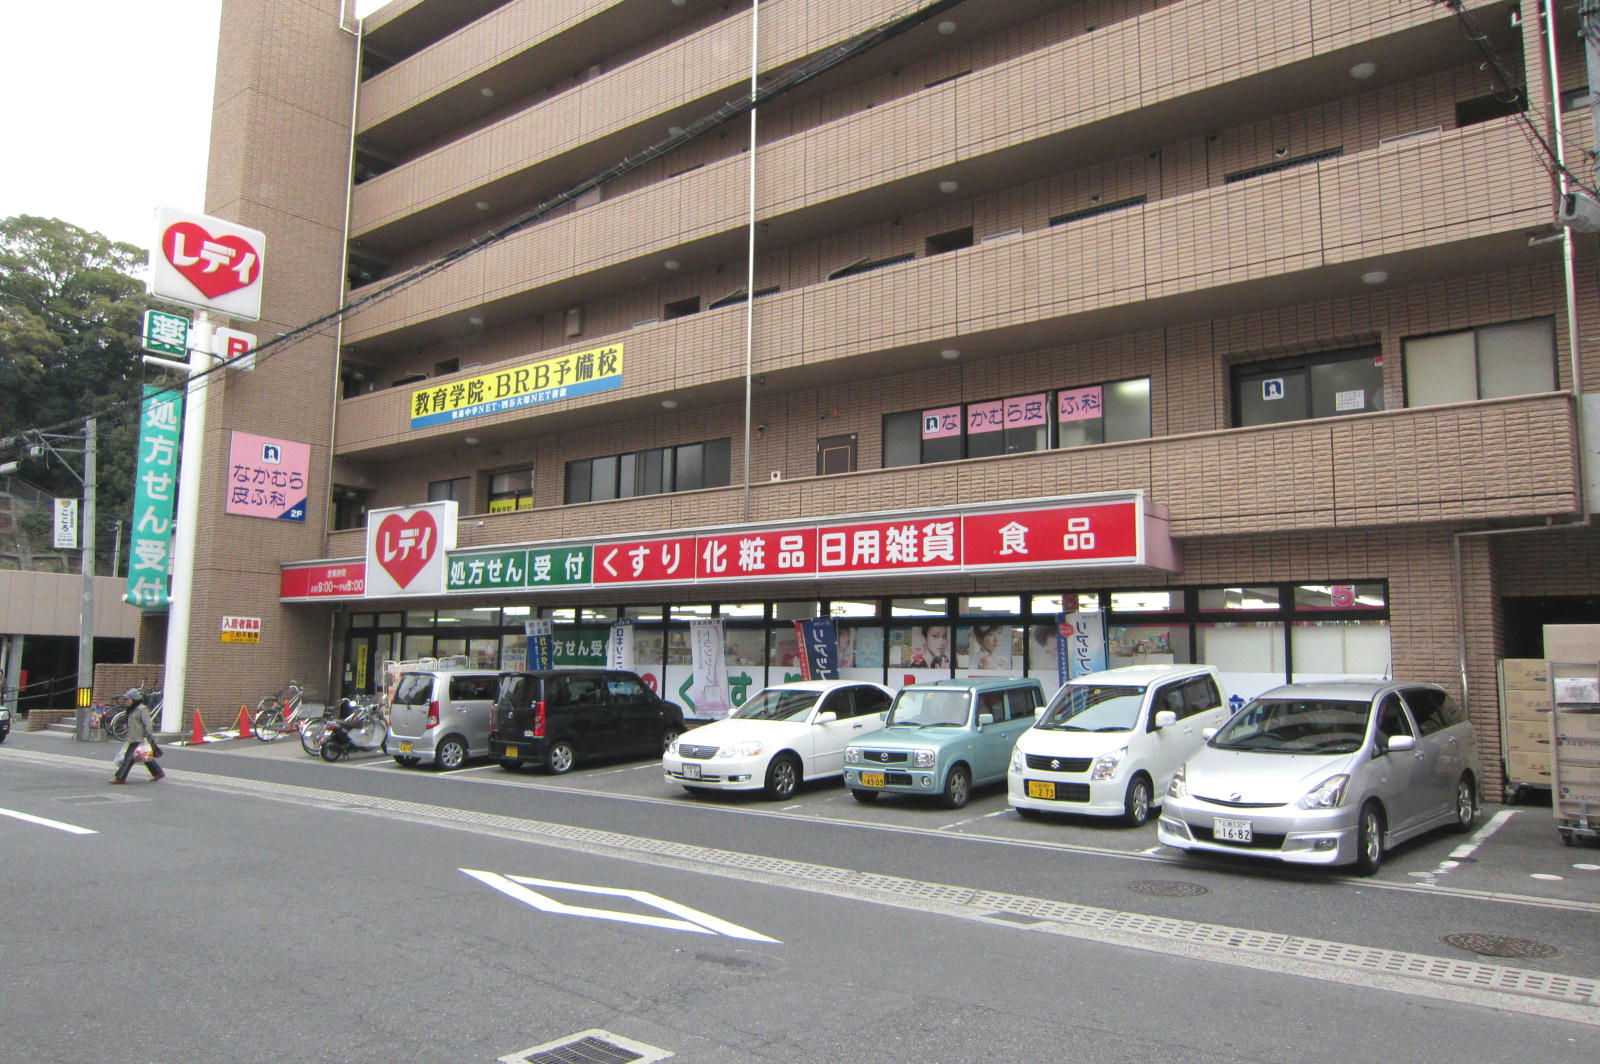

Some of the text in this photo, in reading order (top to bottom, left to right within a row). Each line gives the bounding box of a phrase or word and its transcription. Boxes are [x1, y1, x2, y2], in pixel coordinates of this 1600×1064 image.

[151, 313, 187, 351] 薬
[233, 464, 305, 491] なかむら
[130, 396, 178, 607] 処方せん受付
[231, 486, 287, 516] 皮ふ科
[290, 509, 304, 518] 2F
[450, 517, 1096, 587] 処方せん 受付 くすり 化粧品 日用雑貨 食品
[1331, 584, 1355, 607] 5
[1223, 827, 1250, 841] 16-82
